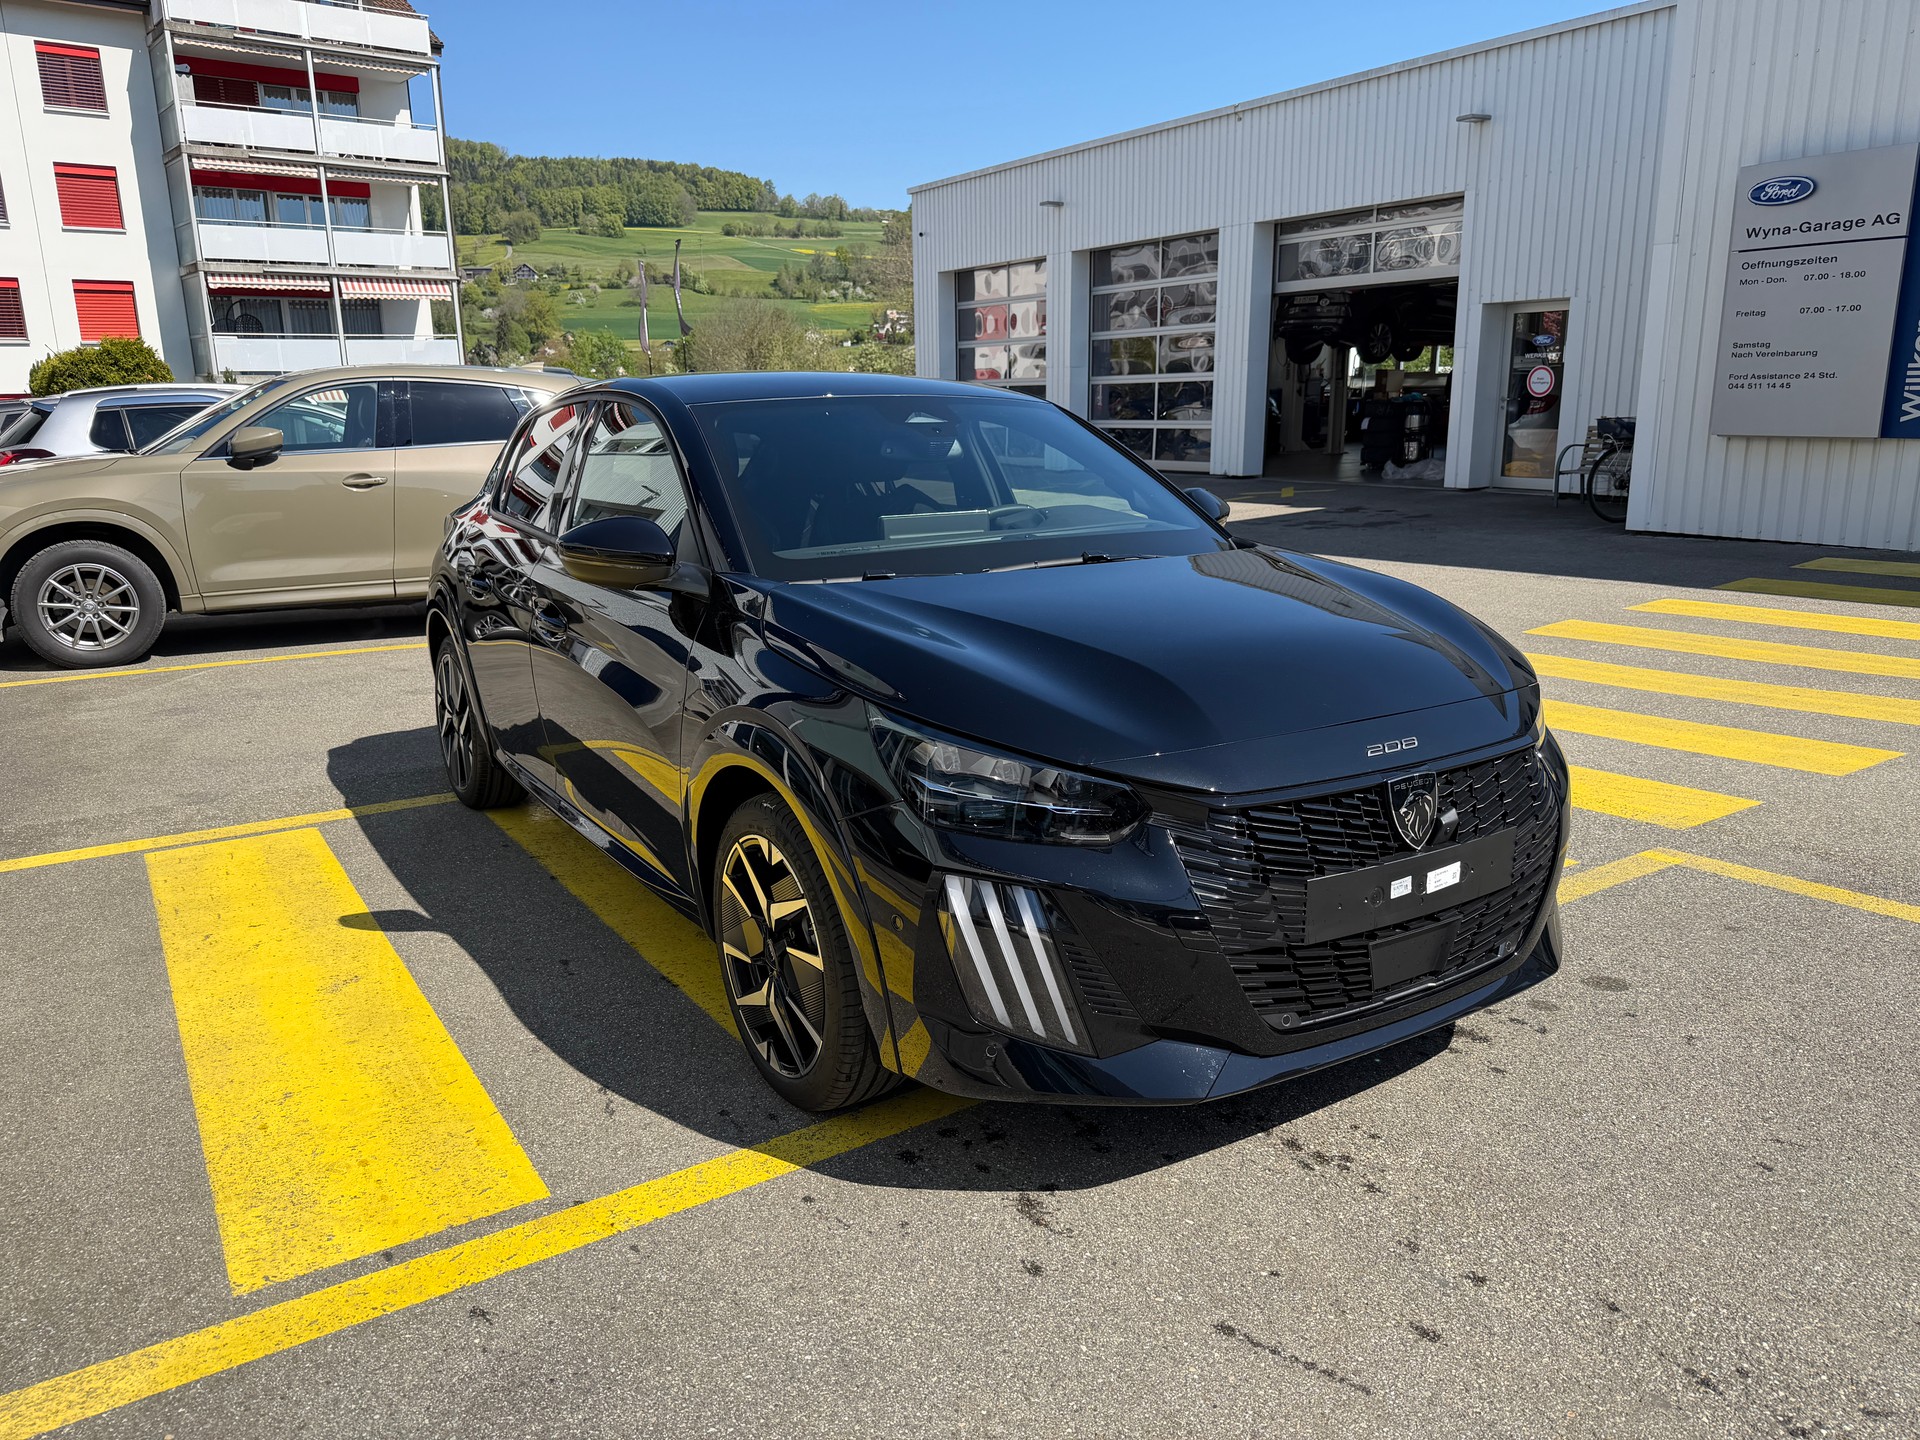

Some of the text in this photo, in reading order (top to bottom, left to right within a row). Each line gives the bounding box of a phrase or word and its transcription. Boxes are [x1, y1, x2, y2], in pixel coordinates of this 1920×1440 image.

[1746, 212, 1900, 239] Wyna-Garage AG
[1741, 255, 1838, 270] Oeffnungszeiten
[1803, 273, 1829, 281] 07.00
[1840, 270, 1866, 279] 18.00
[1735, 310, 1766, 318] Freitag
[1799, 306, 1825, 314] 07.00
[1835, 304, 1862, 312] 17.00
[1732, 341, 1771, 349] Samstag
[1818, 371, 1838, 379] Std.
[1367, 736, 1418, 757] 208
[1393, 777, 1434, 792] PEUGEOT
